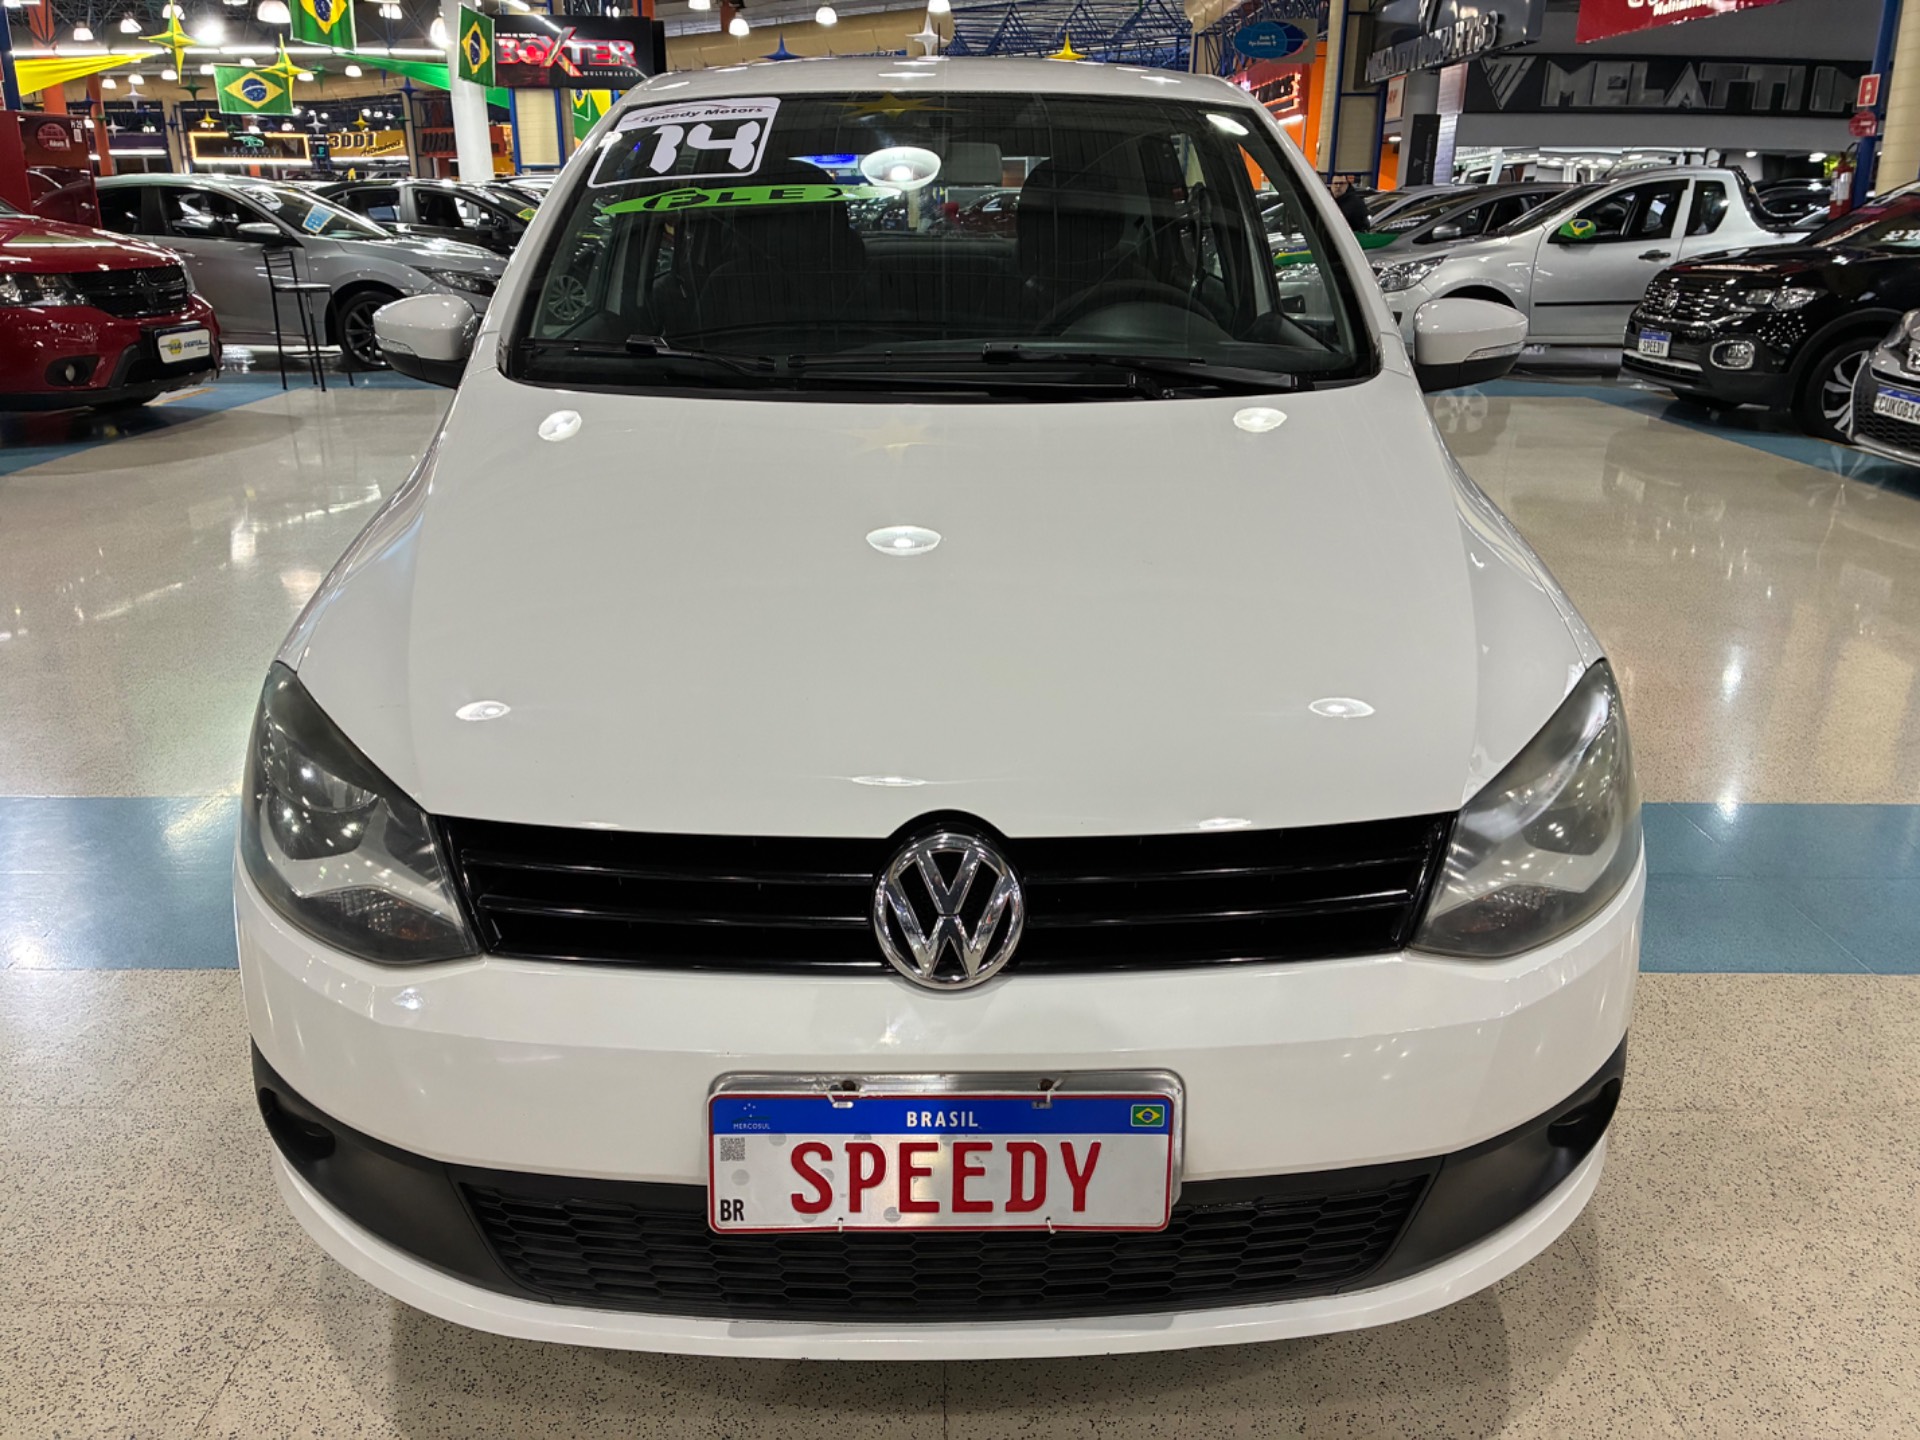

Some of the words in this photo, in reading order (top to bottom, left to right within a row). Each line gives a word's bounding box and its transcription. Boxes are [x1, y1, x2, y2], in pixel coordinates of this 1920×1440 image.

[495, 26, 637, 77] BOXTER
[1541, 59, 1806, 111] MELATTI
[641, 110, 701, 123] Speedy
[704, 107, 763, 116] Motors
[649, 120, 760, 174] 14
[906, 1111, 979, 1128] BRASIL
[791, 1142, 1102, 1214] SPEEDY
[720, 1199, 745, 1222] BR
